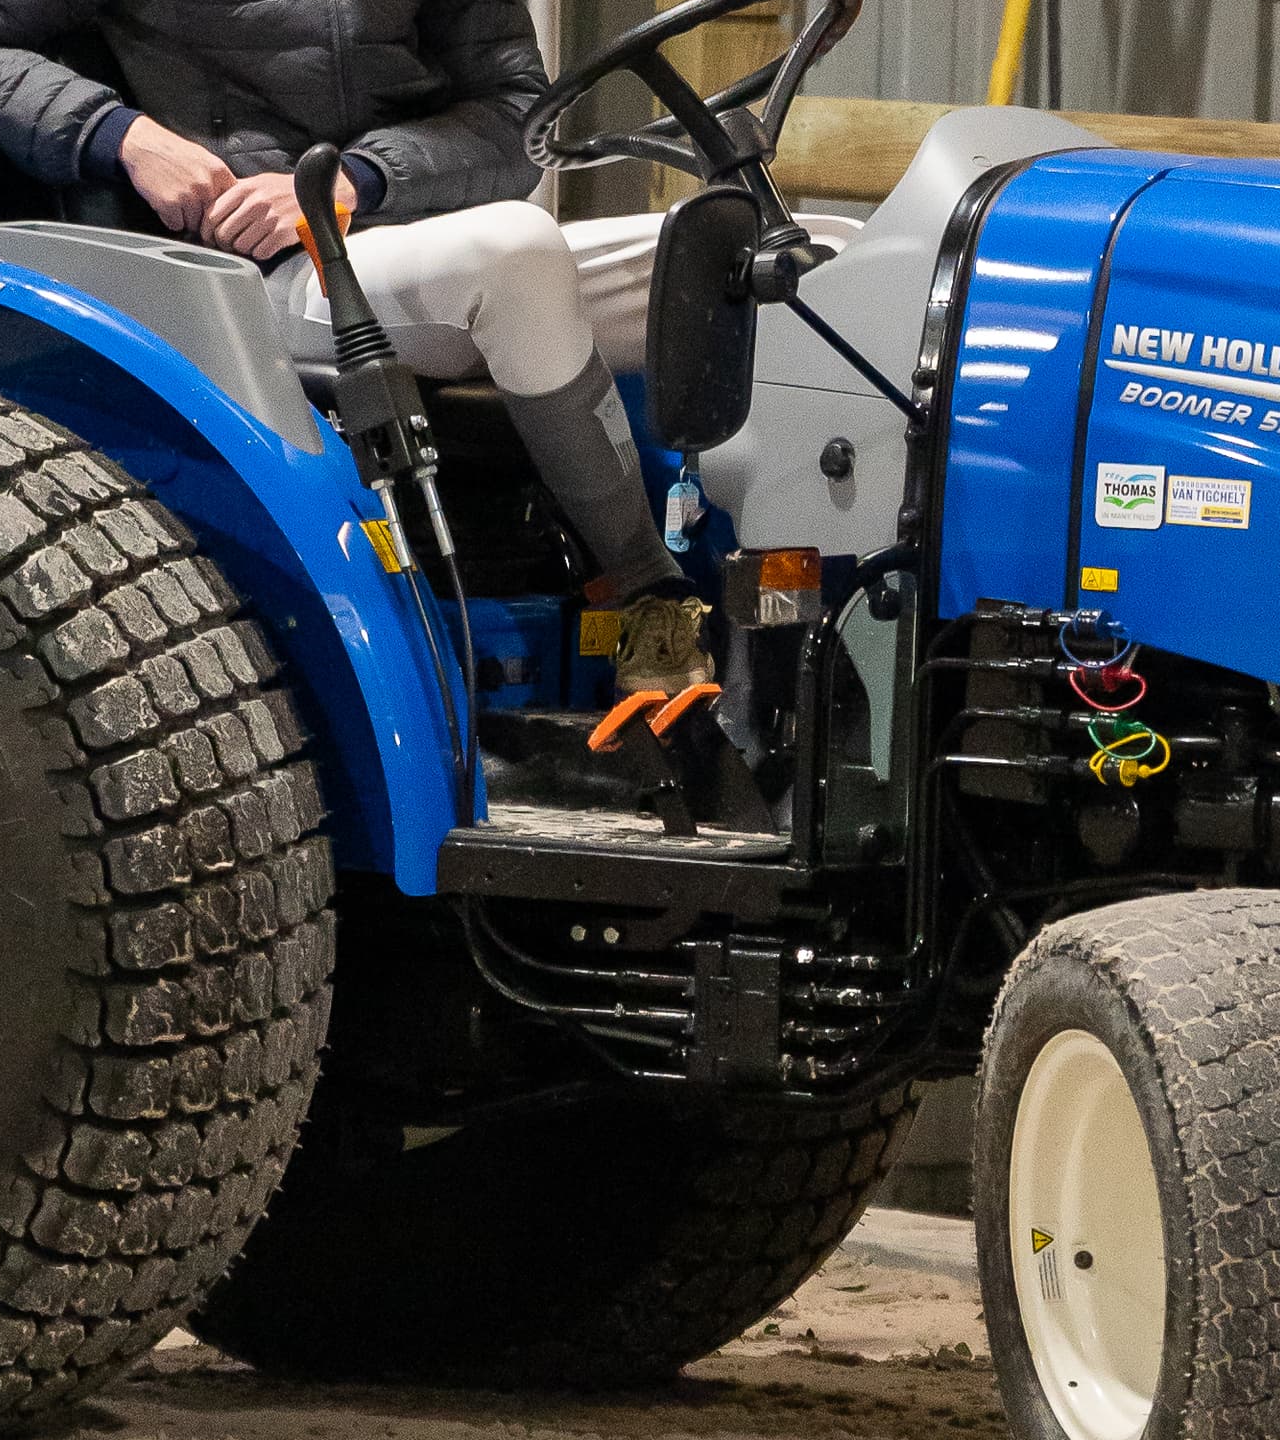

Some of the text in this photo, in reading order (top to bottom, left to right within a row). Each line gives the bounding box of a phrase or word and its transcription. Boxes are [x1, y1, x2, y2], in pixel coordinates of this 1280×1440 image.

[1111, 324, 1194, 363] NEW
[1119, 381, 1253, 426] BOOMER
[1104, 483, 1157, 498] THOMAS
[1172, 488, 1246, 505] VAN TIGCHELT
